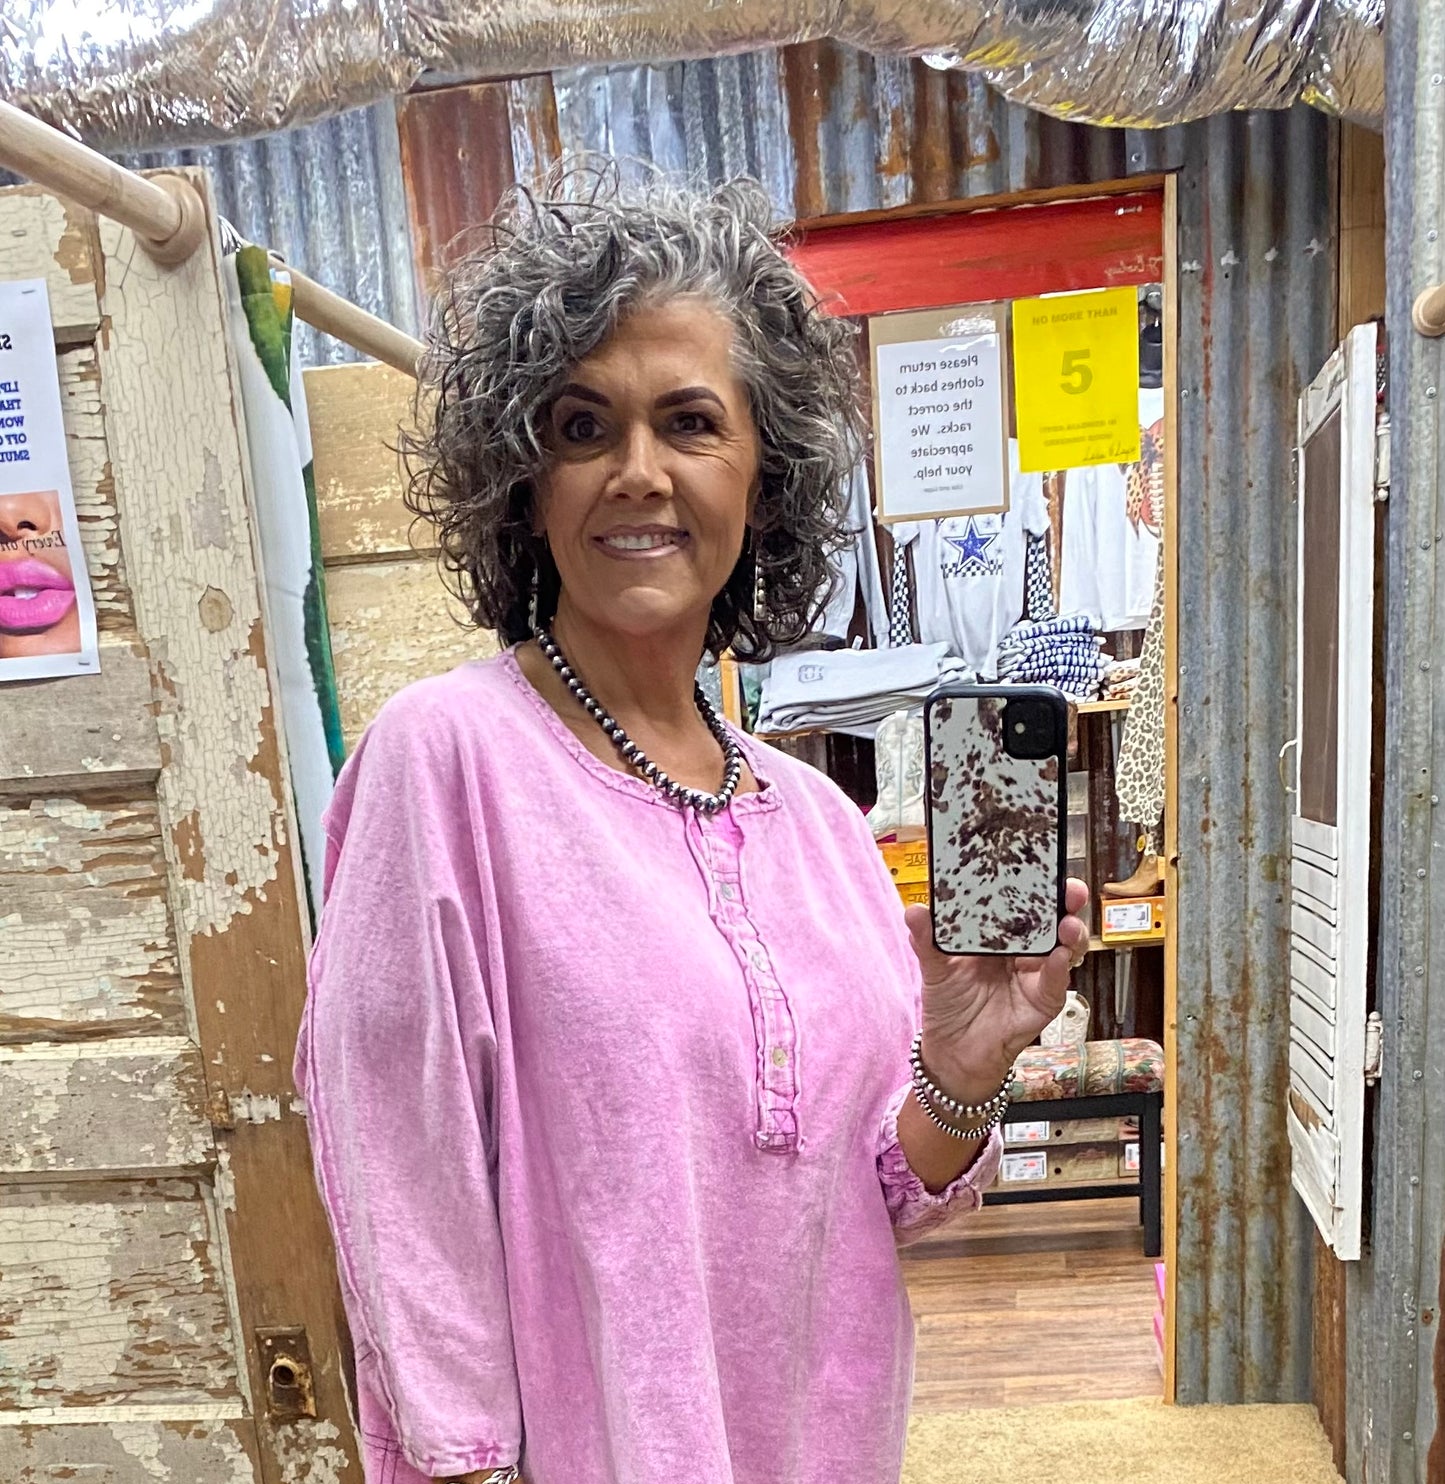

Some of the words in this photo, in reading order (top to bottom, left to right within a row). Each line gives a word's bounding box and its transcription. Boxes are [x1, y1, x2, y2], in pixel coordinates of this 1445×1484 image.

[1032, 316, 1048, 326] NO
[1051, 311, 1084, 324] MORE
[1087, 306, 1118, 319] THAN
[1060, 348, 1093, 395] 5
